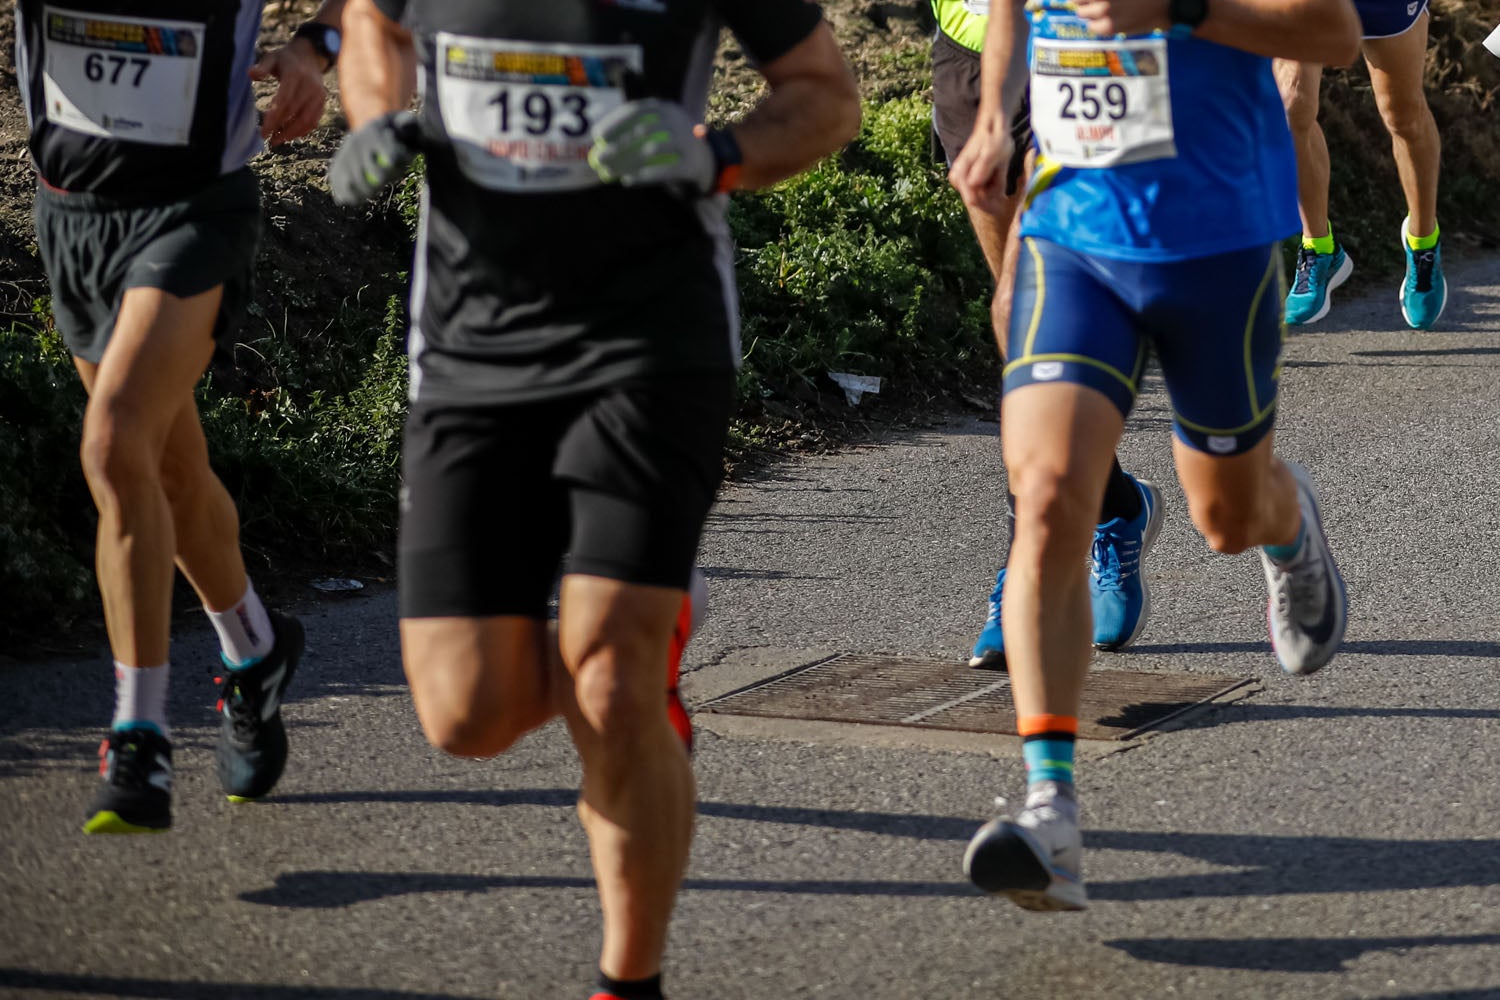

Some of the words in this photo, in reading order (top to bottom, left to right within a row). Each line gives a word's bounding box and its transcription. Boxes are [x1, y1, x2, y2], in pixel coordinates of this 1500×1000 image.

[85, 53, 152, 88] 677
[488, 89, 591, 138] 193
[1058, 82, 1129, 121] 259
